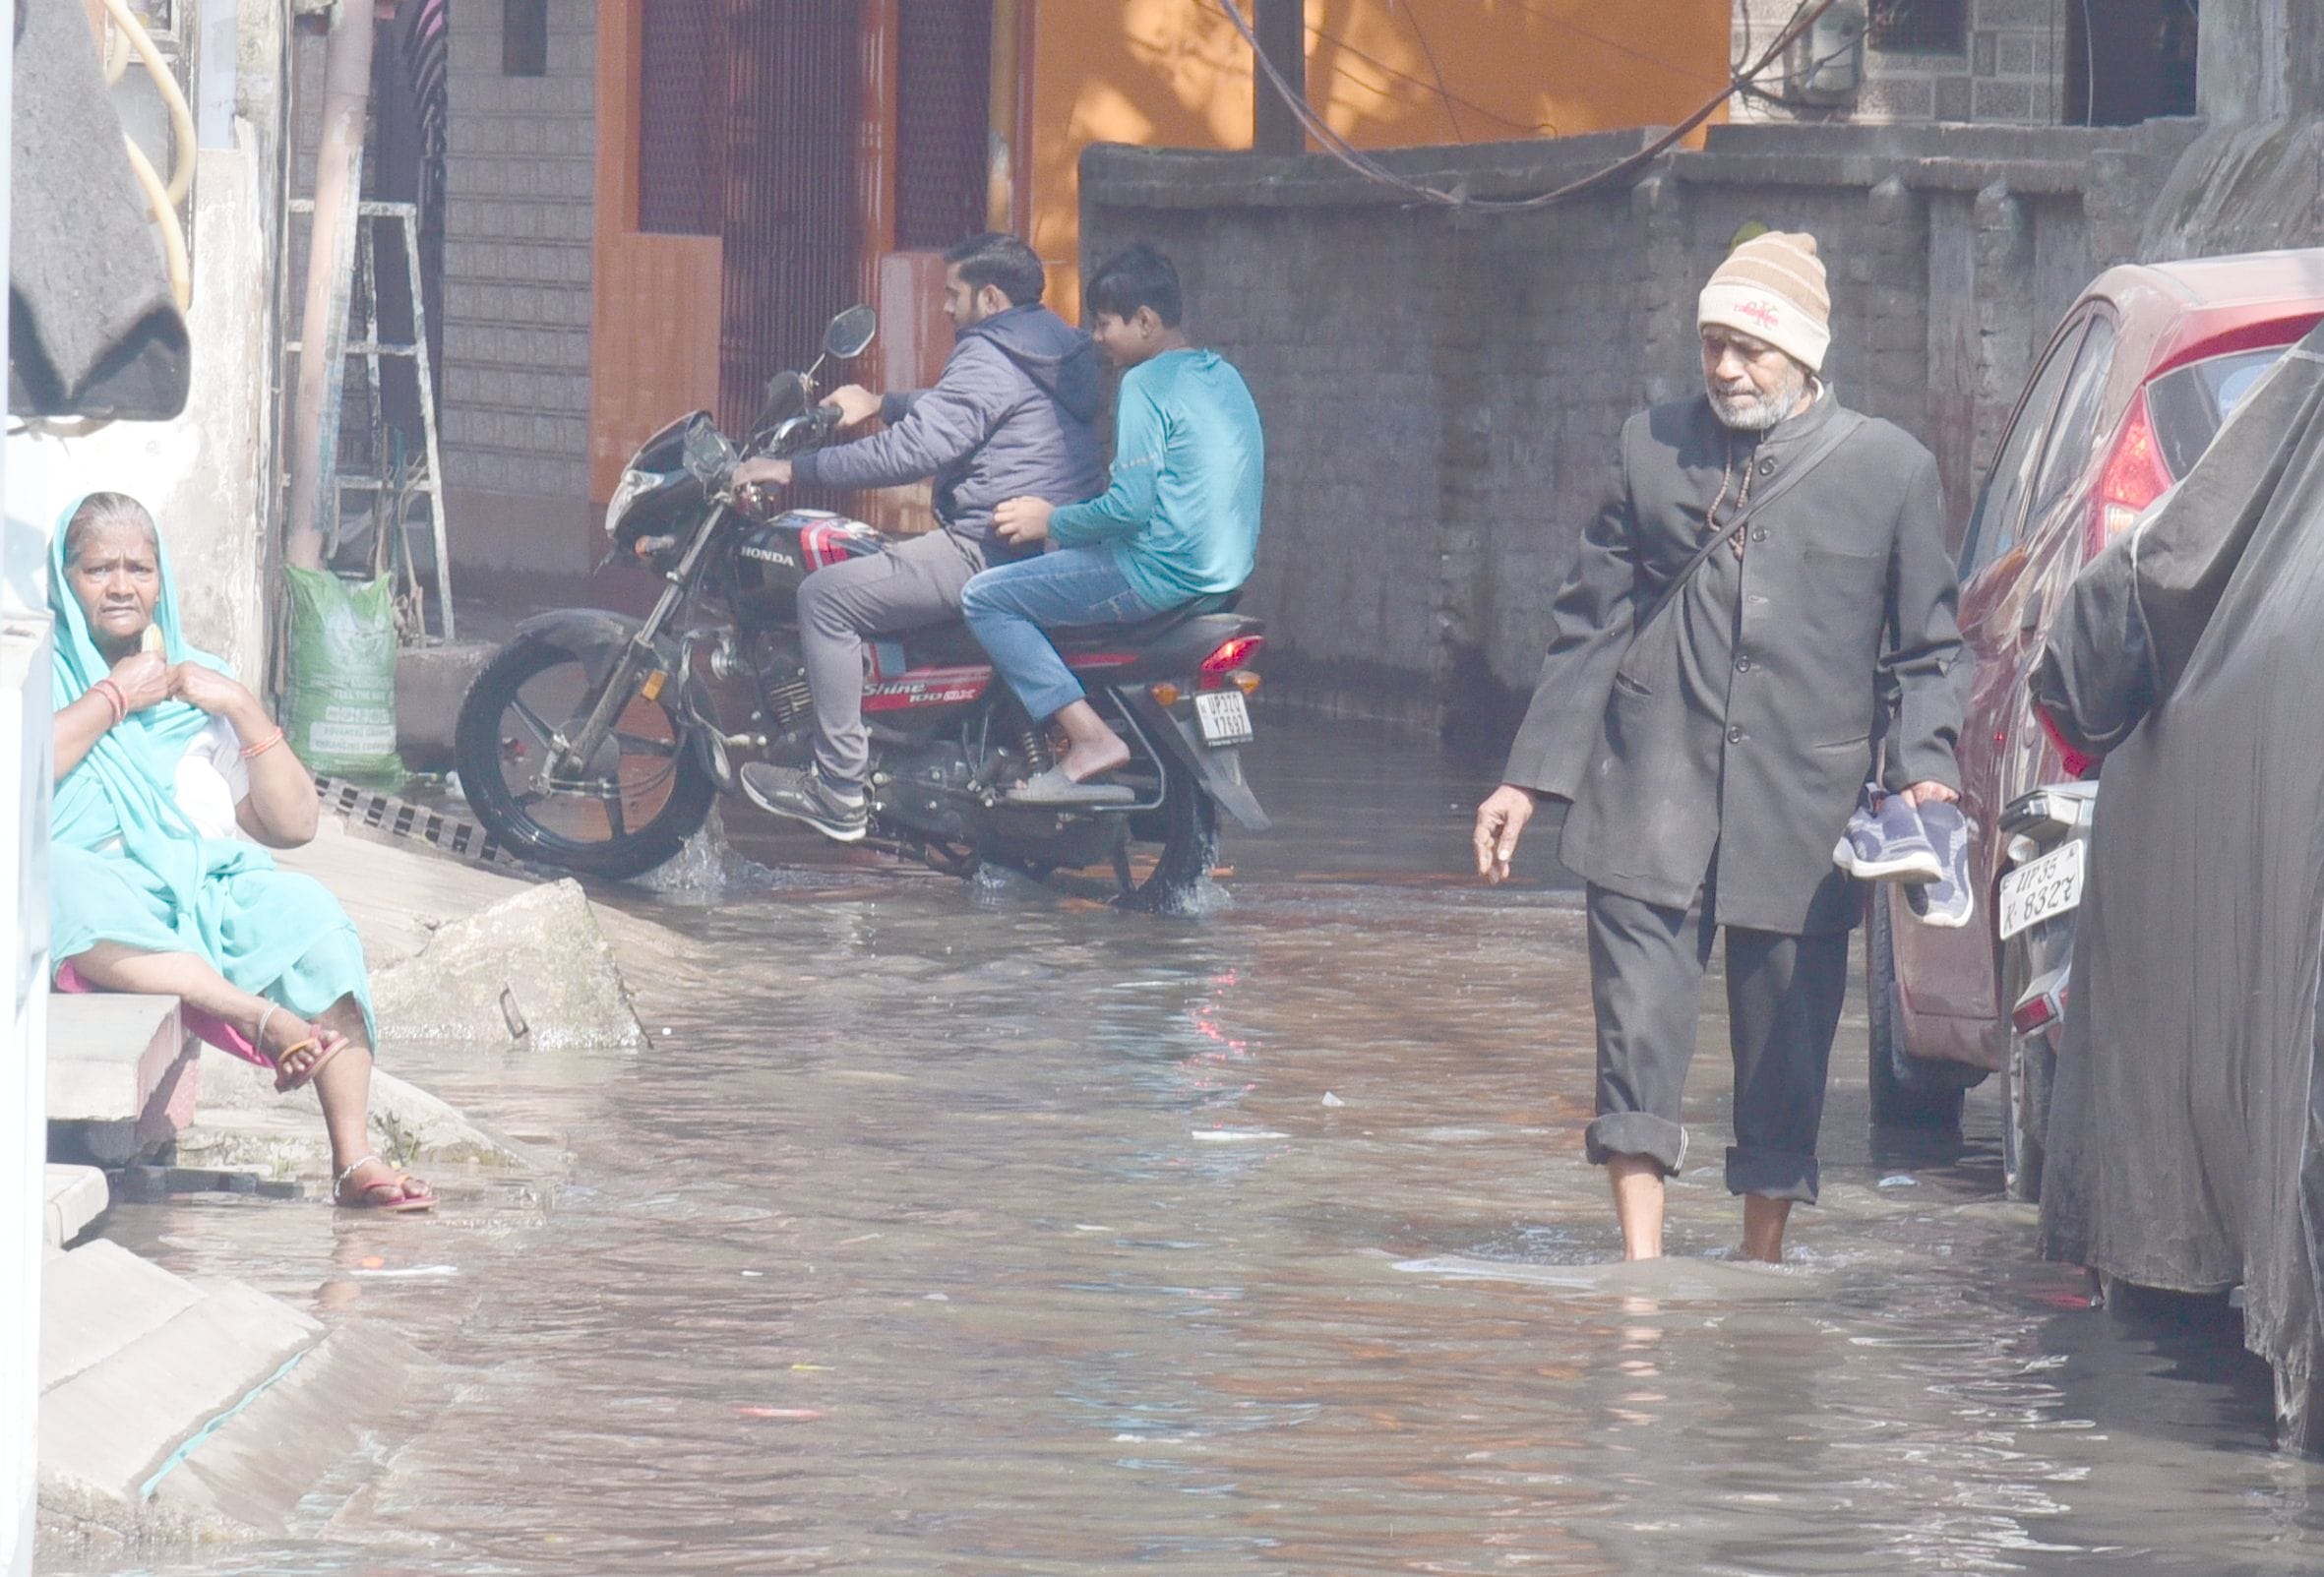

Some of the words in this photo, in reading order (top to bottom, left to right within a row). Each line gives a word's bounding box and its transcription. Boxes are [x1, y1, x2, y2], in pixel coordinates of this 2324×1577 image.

[740, 546, 795, 568] HONDA
[862, 682, 926, 698] Shine
[909, 692, 944, 703] 100
